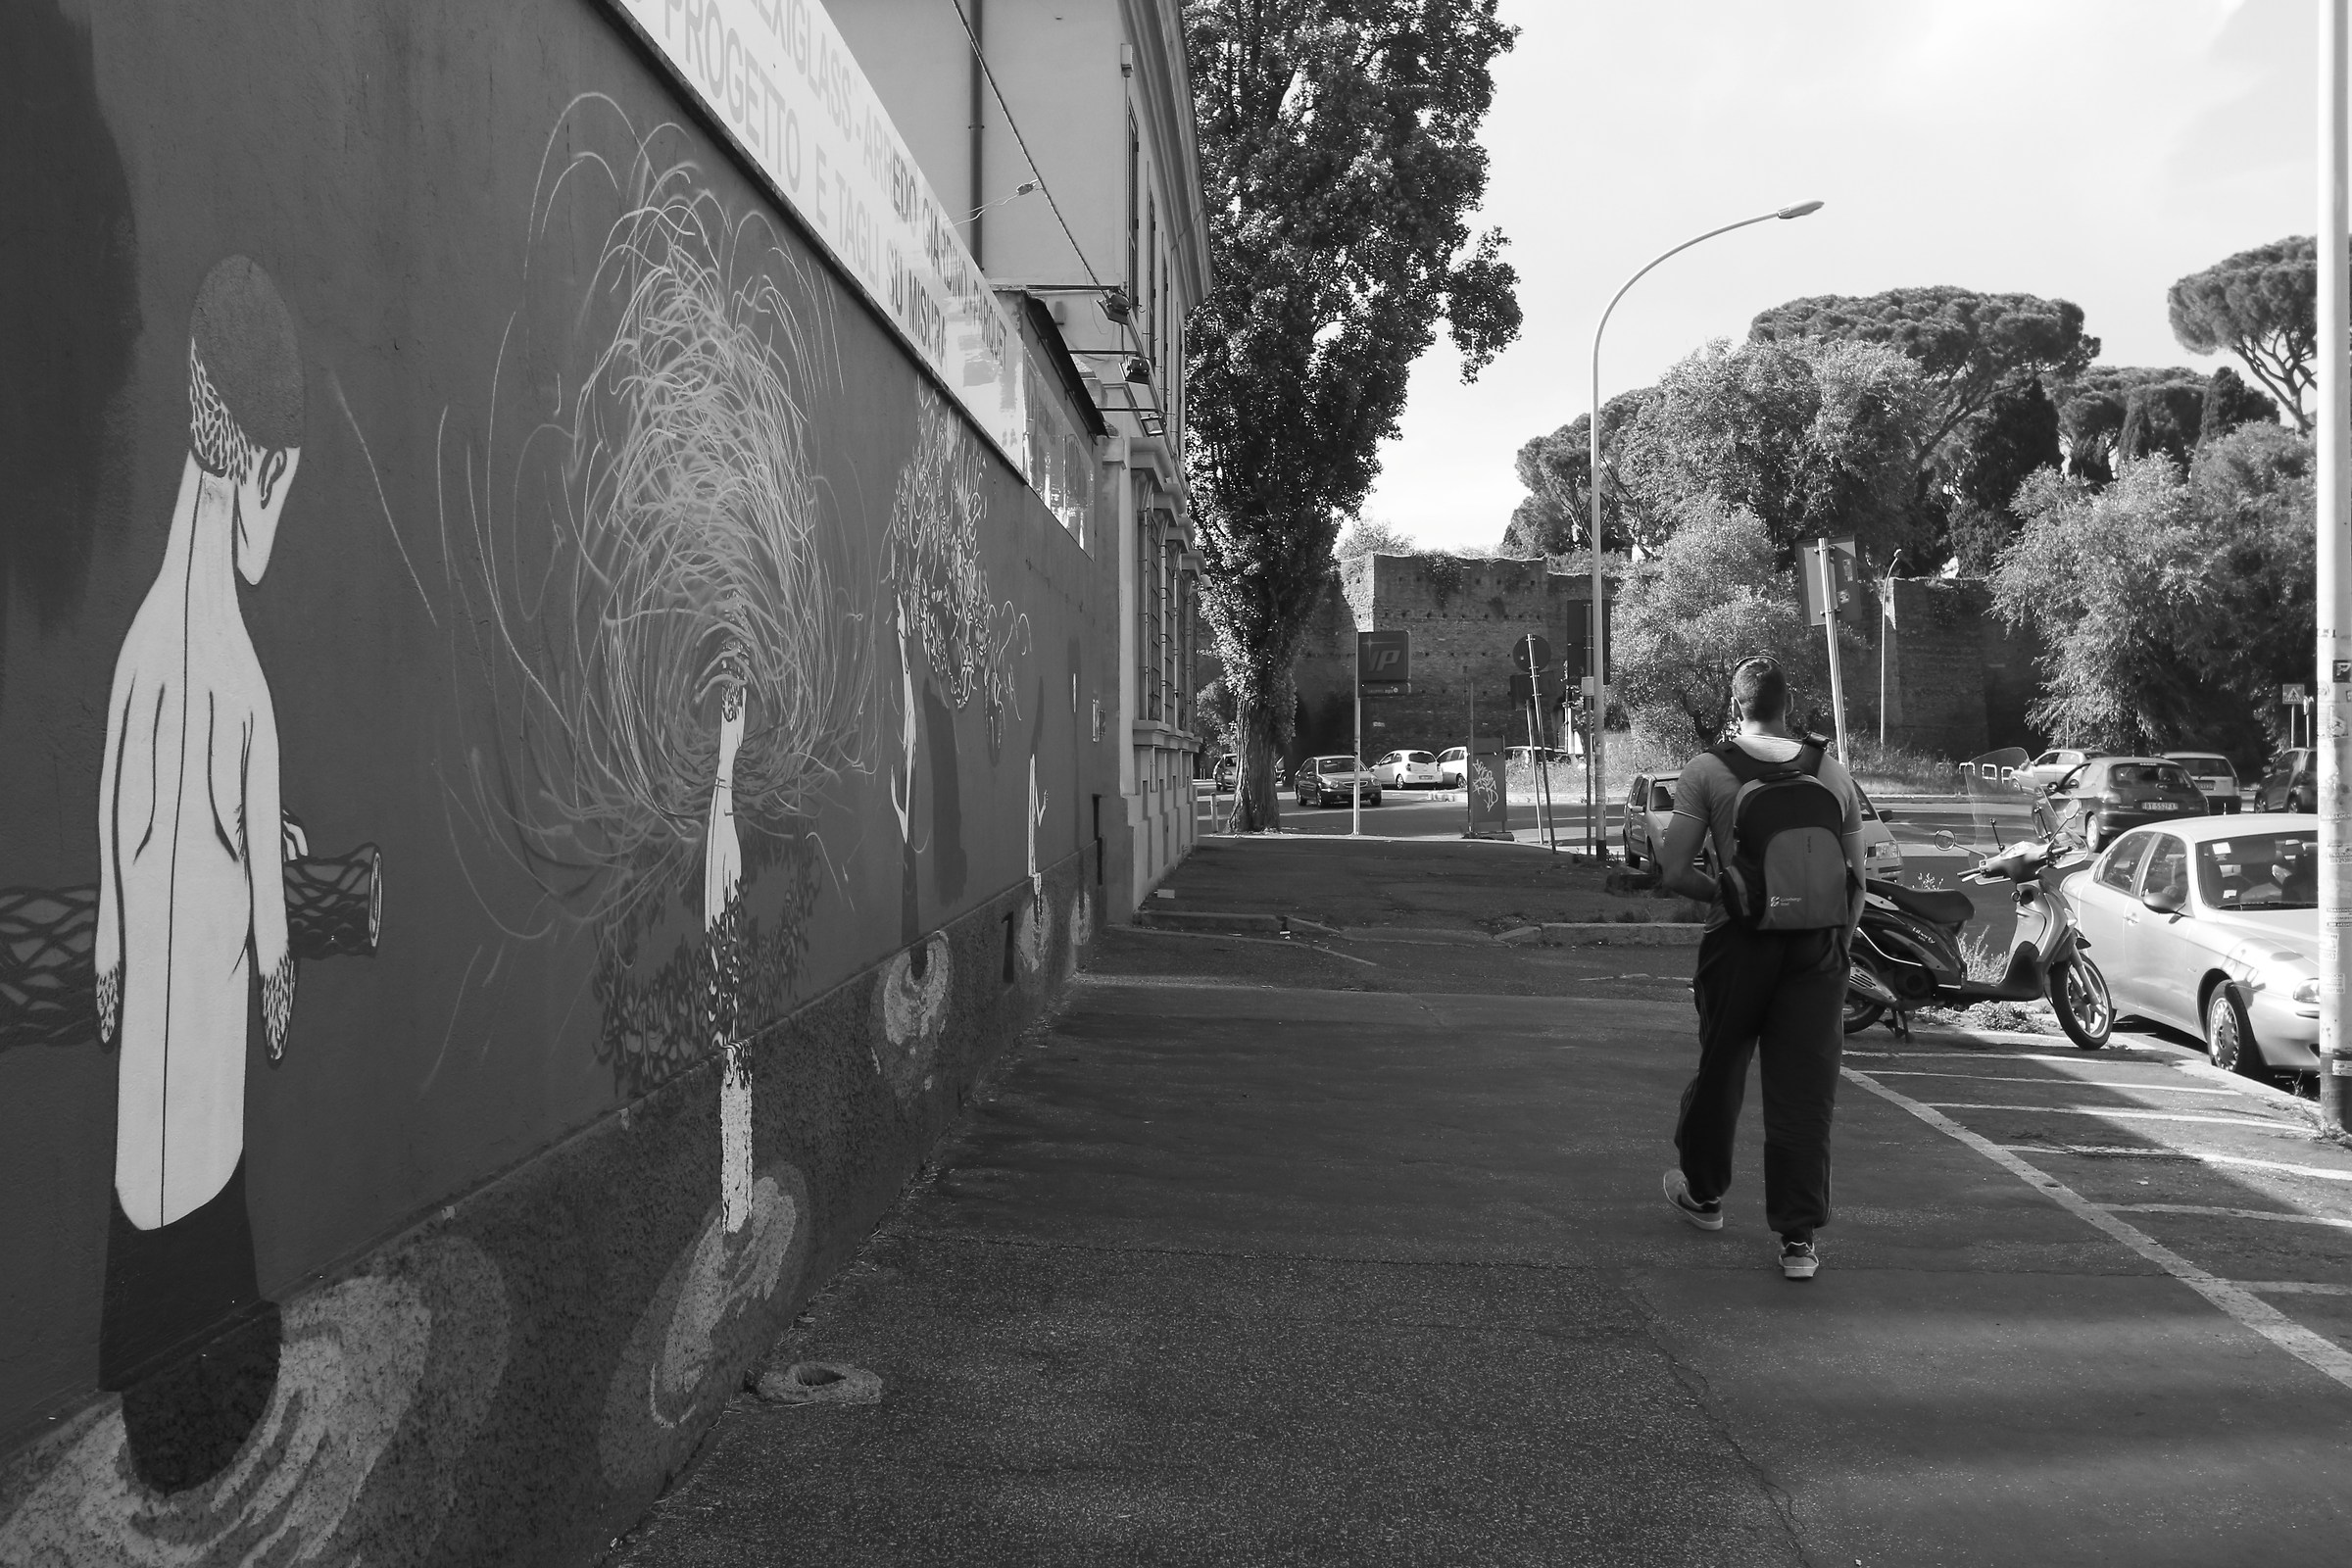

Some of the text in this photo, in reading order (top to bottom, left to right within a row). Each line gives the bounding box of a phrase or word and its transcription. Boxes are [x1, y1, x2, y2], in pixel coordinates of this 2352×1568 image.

[815, 143, 827, 228] E
[835, 169, 879, 290] TAGLI
[886, 238, 903, 317] SU
[863, 104, 917, 237] ARREDO
